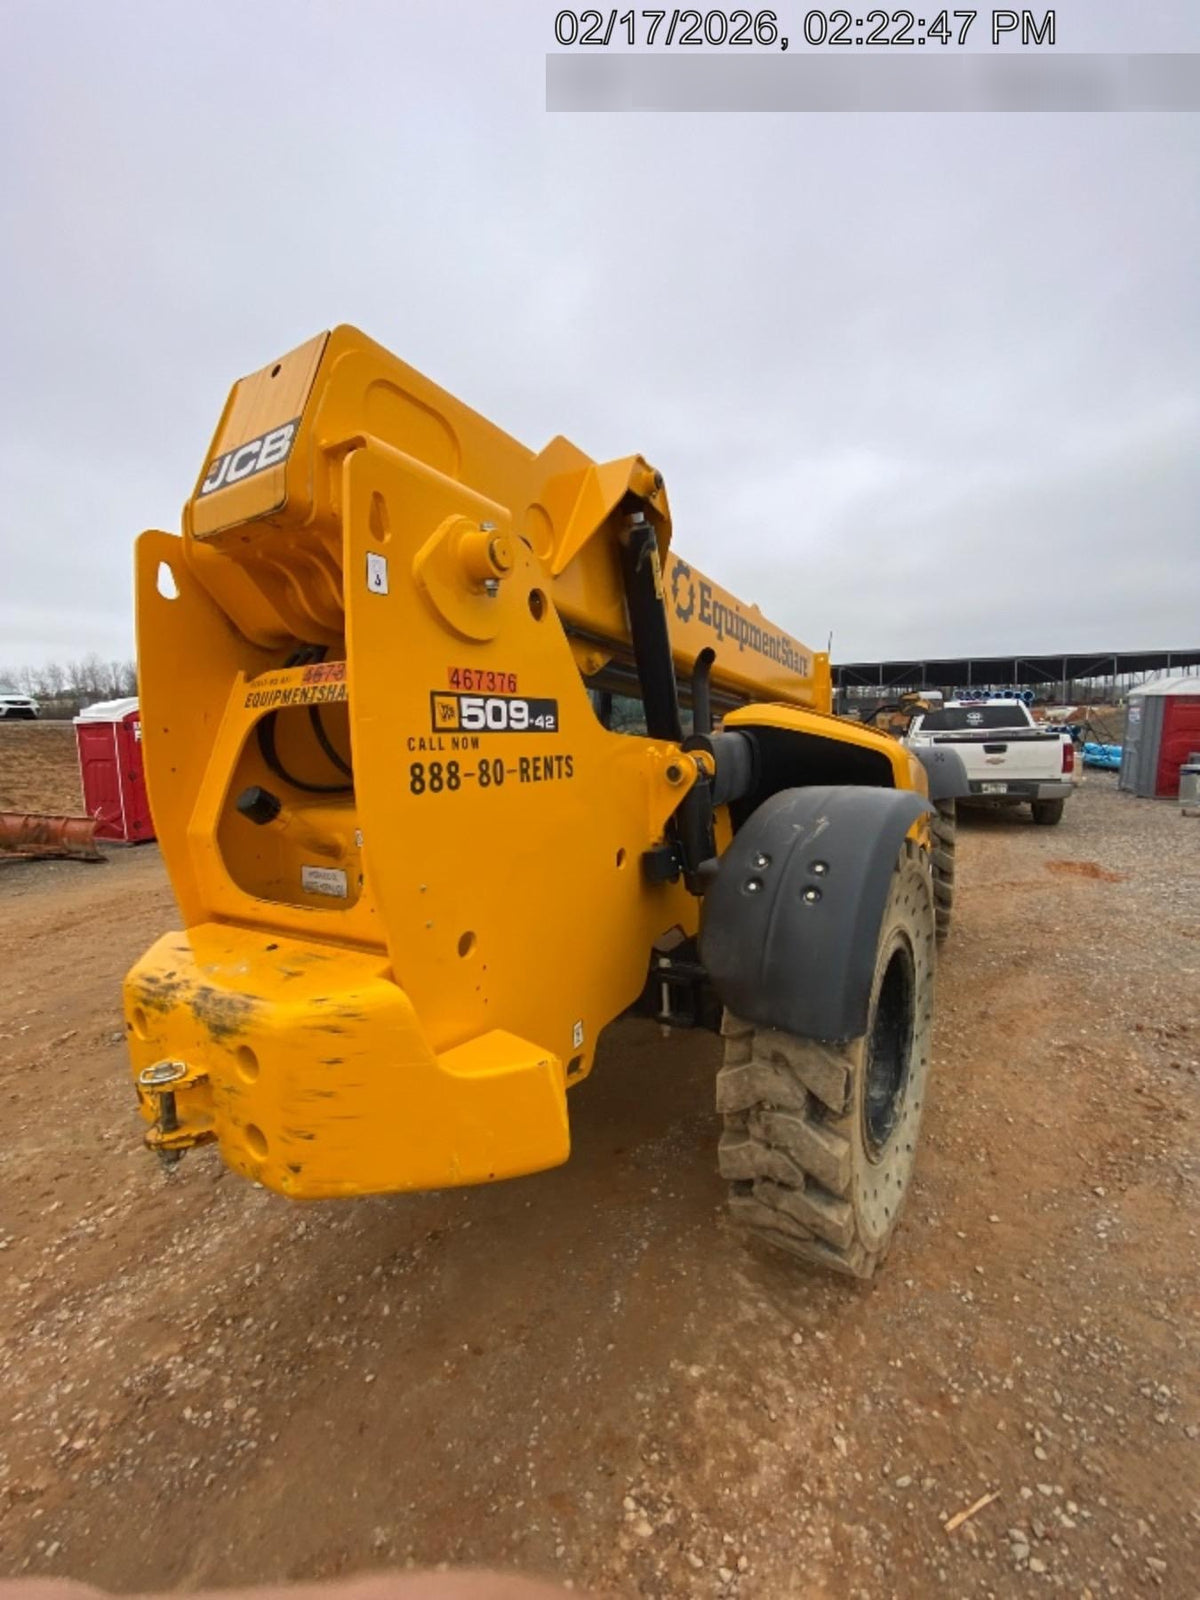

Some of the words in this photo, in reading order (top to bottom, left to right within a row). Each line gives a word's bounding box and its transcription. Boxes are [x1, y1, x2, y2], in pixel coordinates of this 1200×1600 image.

[201, 423, 295, 494] JCB
[698, 579, 808, 678] EquipmentShare
[303, 662, 346, 684] 4673
[450, 667, 518, 694] 467376
[244, 683, 349, 709] EQUIPMENTSHA
[407, 737, 446, 752] CALL
[452, 737, 480, 750] NOW
[409, 754, 575, 796] 888-80-RENTS
